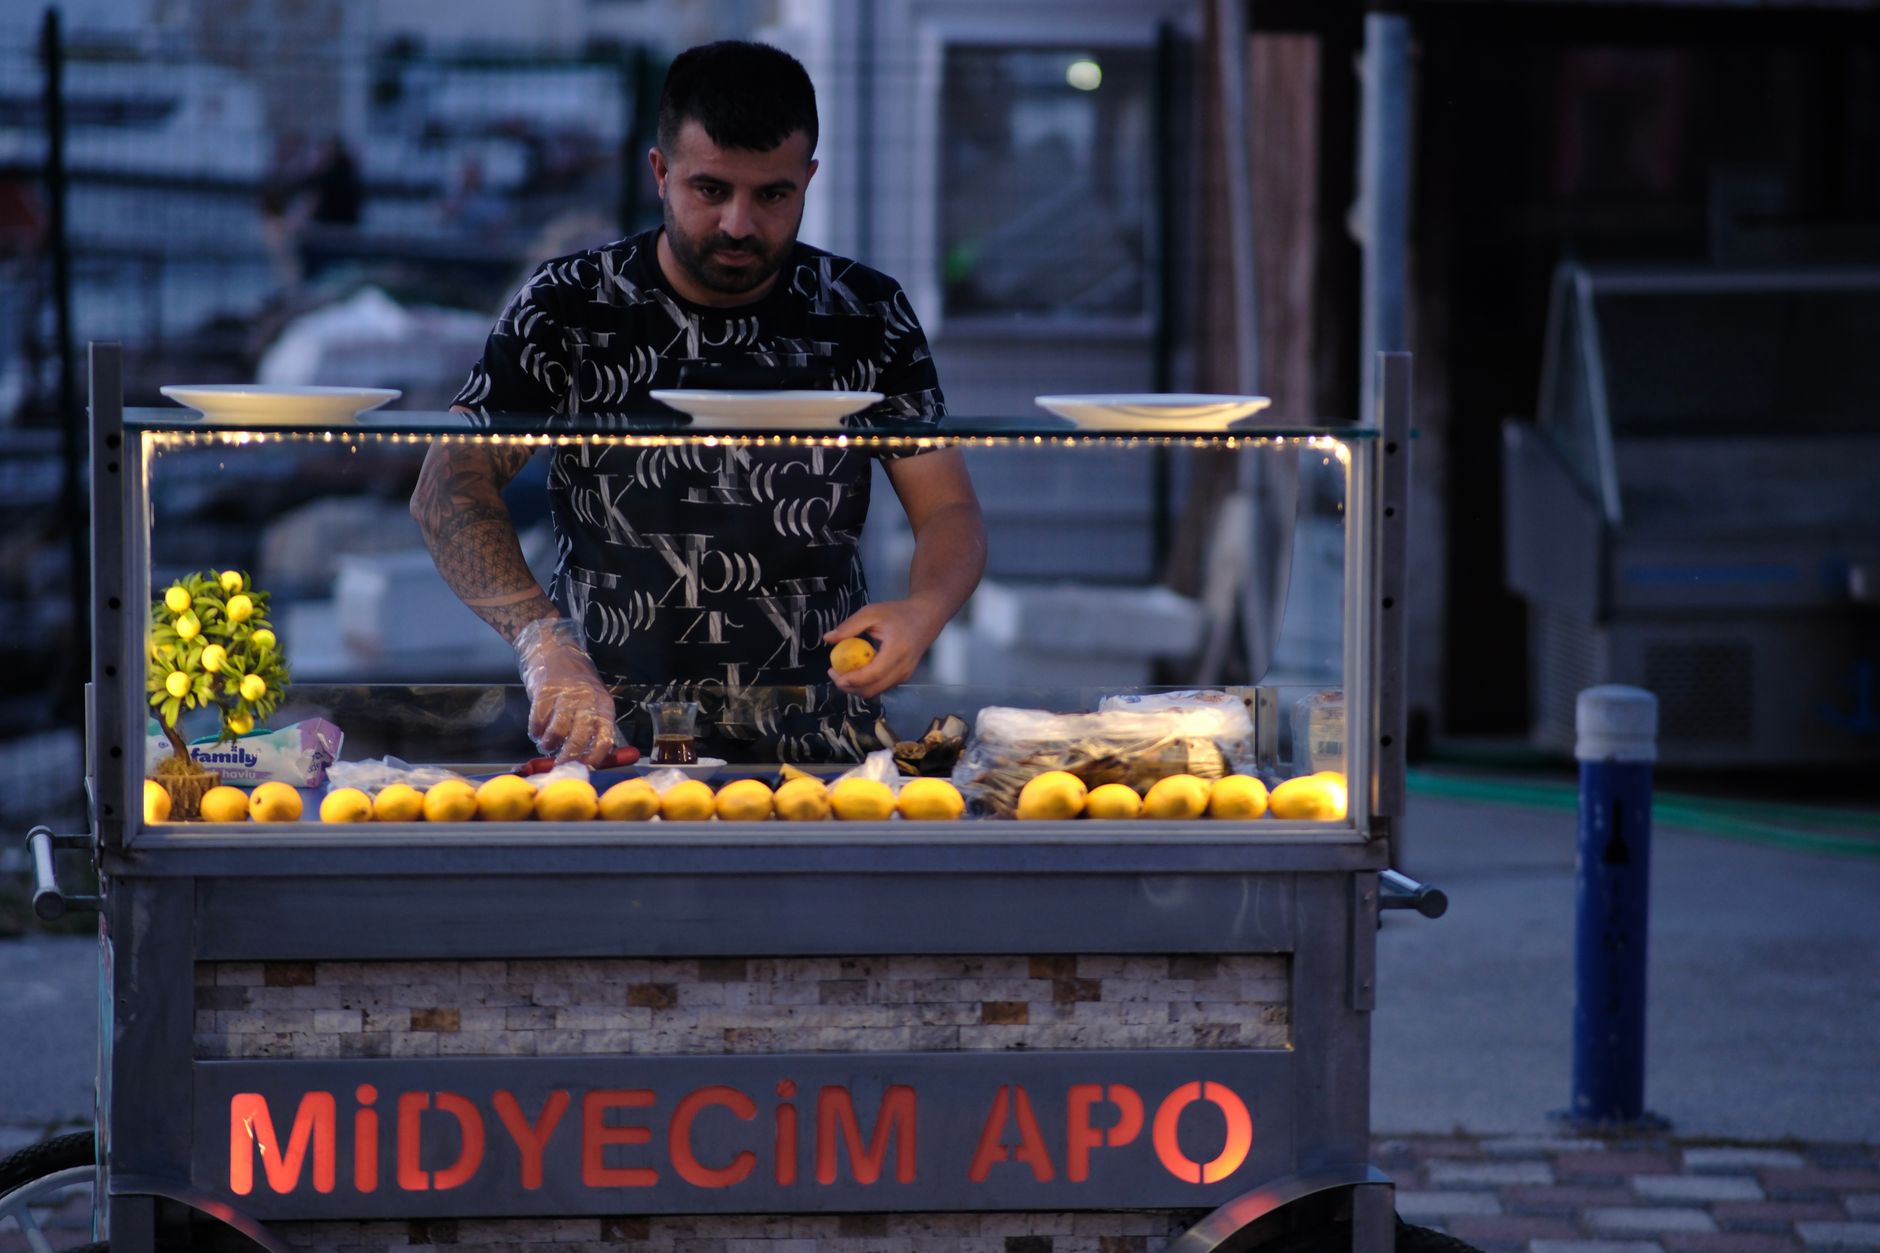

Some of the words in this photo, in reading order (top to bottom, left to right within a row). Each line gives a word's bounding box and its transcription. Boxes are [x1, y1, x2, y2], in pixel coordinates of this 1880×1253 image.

[190, 745, 258, 767] family
[221, 769, 257, 779] havlu
[967, 1080, 1254, 1185] APO
